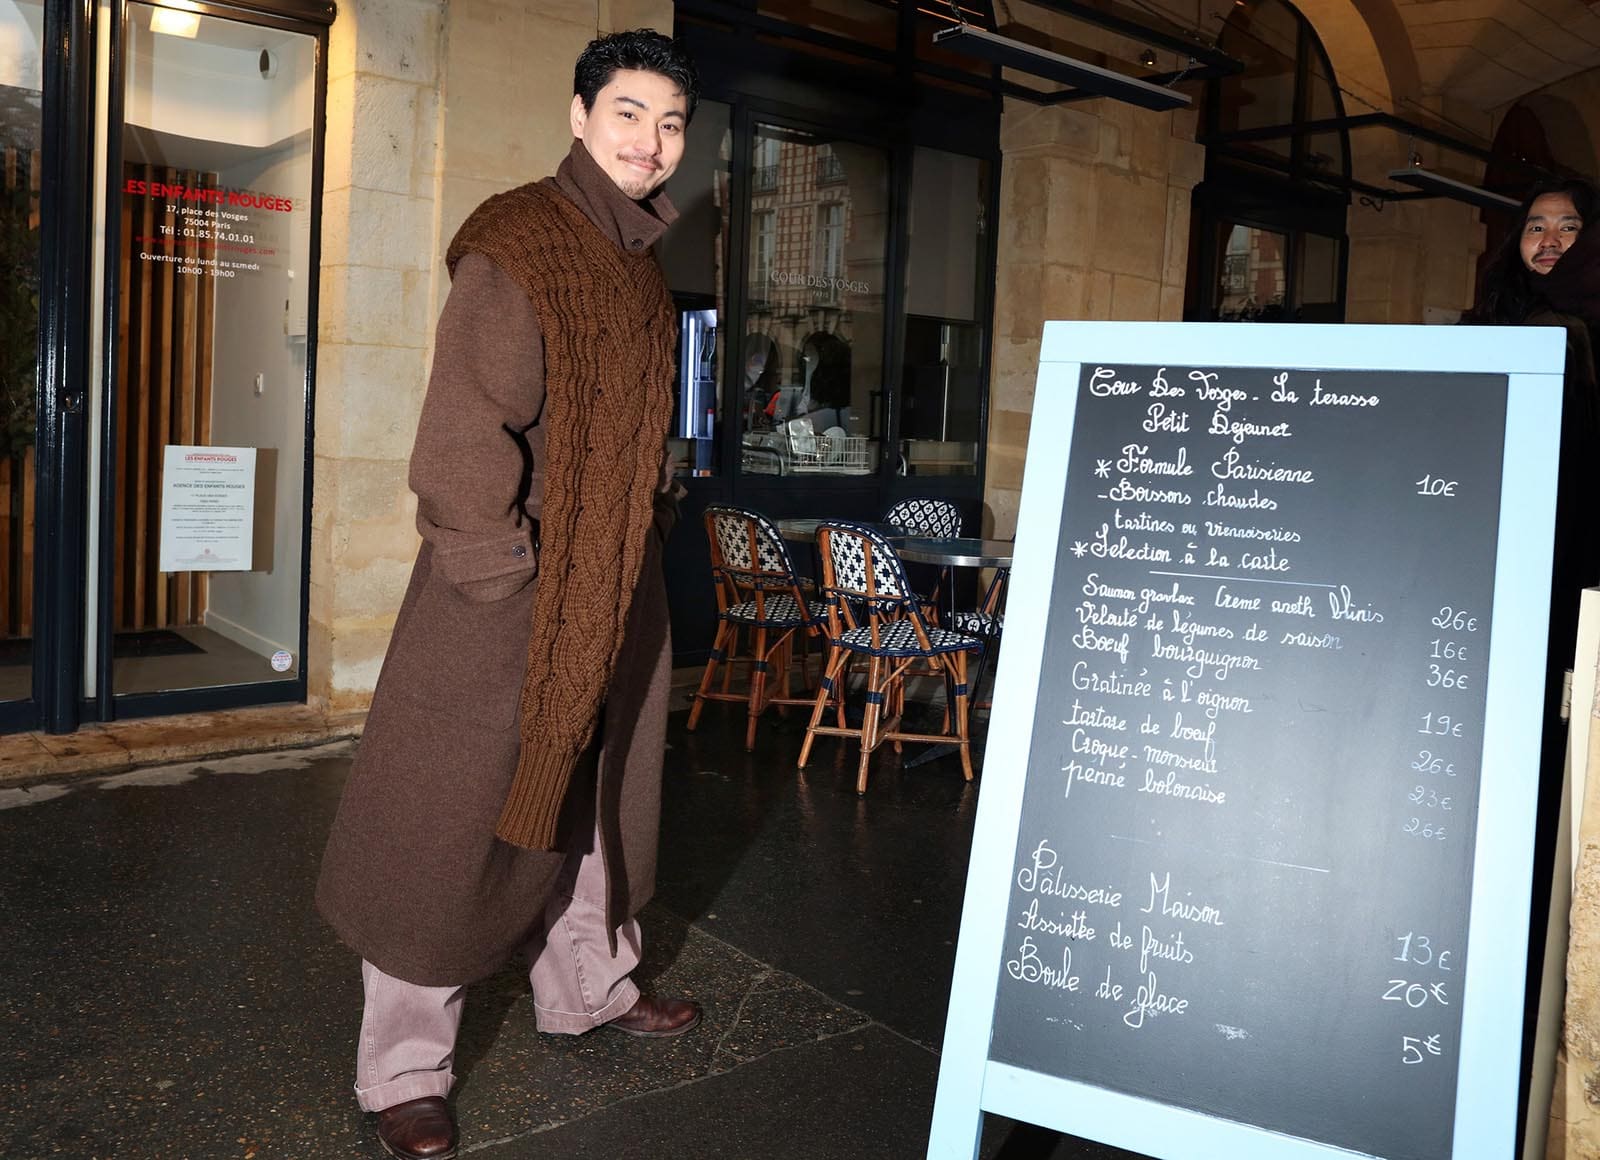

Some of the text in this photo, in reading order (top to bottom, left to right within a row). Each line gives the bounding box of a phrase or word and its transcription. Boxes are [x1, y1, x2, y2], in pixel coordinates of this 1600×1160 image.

[151, 182, 224, 204] ENFANTS
[228, 191, 292, 212] ROUGES
[181, 207, 203, 217] place
[205, 209, 218, 218] des
[221, 211, 248, 221] Vosges
[184, 218, 231, 230] 75004 Paris
[160, 226, 174, 236] Tél
[183, 228, 254, 244] 01.85.74.01.01
[140, 253, 182, 264] Ouverture
[185, 256, 195, 265] du
[232, 260, 260, 271] samedi
[177, 266, 202, 275] 10h00
[771, 271, 870, 294] COUR DES VOSGES
[1090, 367, 1142, 397] Cour
[1149, 368, 1185, 397] Des
[1188, 371, 1247, 411] Vosges
[1271, 372, 1299, 403] La
[1310, 379, 1380, 407] terasse
[1143, 402, 1292, 444] Petit Dejeuner
[1116, 444, 1314, 483] Formule Parisienne
[1203, 483, 1278, 511] chaudes
[1416, 474, 1458, 496] 10€
[1115, 508, 1175, 533] tartines
[1182, 523, 1197, 535] ou
[1090, 523, 1172, 564] Selection
[1205, 548, 1230, 567] la
[1238, 548, 1291, 572] carte
[1082, 573, 1136, 600] Saumon
[1138, 582, 1196, 614] gravlax
[1271, 595, 1315, 618] aneth
[1075, 601, 1343, 649] Velouté de légumes de saison
[1431, 606, 1478, 632] 26€
[1152, 634, 1263, 681] bourguignon
[1430, 639, 1467, 661] 16€
[1072, 661, 1151, 697] Gratinée
[1426, 664, 1468, 690] 36€
[1063, 699, 1127, 731] tartare
[1140, 714, 1160, 735] de
[1417, 712, 1463, 738] 19€
[1411, 750, 1457, 777] 26€
[1138, 768, 1226, 803] bolonaise
[1408, 785, 1452, 811] 23€
[1402, 817, 1447, 841] 26€
[1140, 871, 1224, 926] Maison
[1018, 898, 1194, 974] Assiette de fruits
[1393, 931, 1451, 970] 13€
[1007, 936, 1189, 1028] Boule de glace
[1382, 979, 1449, 1008] 20€
[1402, 1033, 1441, 1064] 5€
